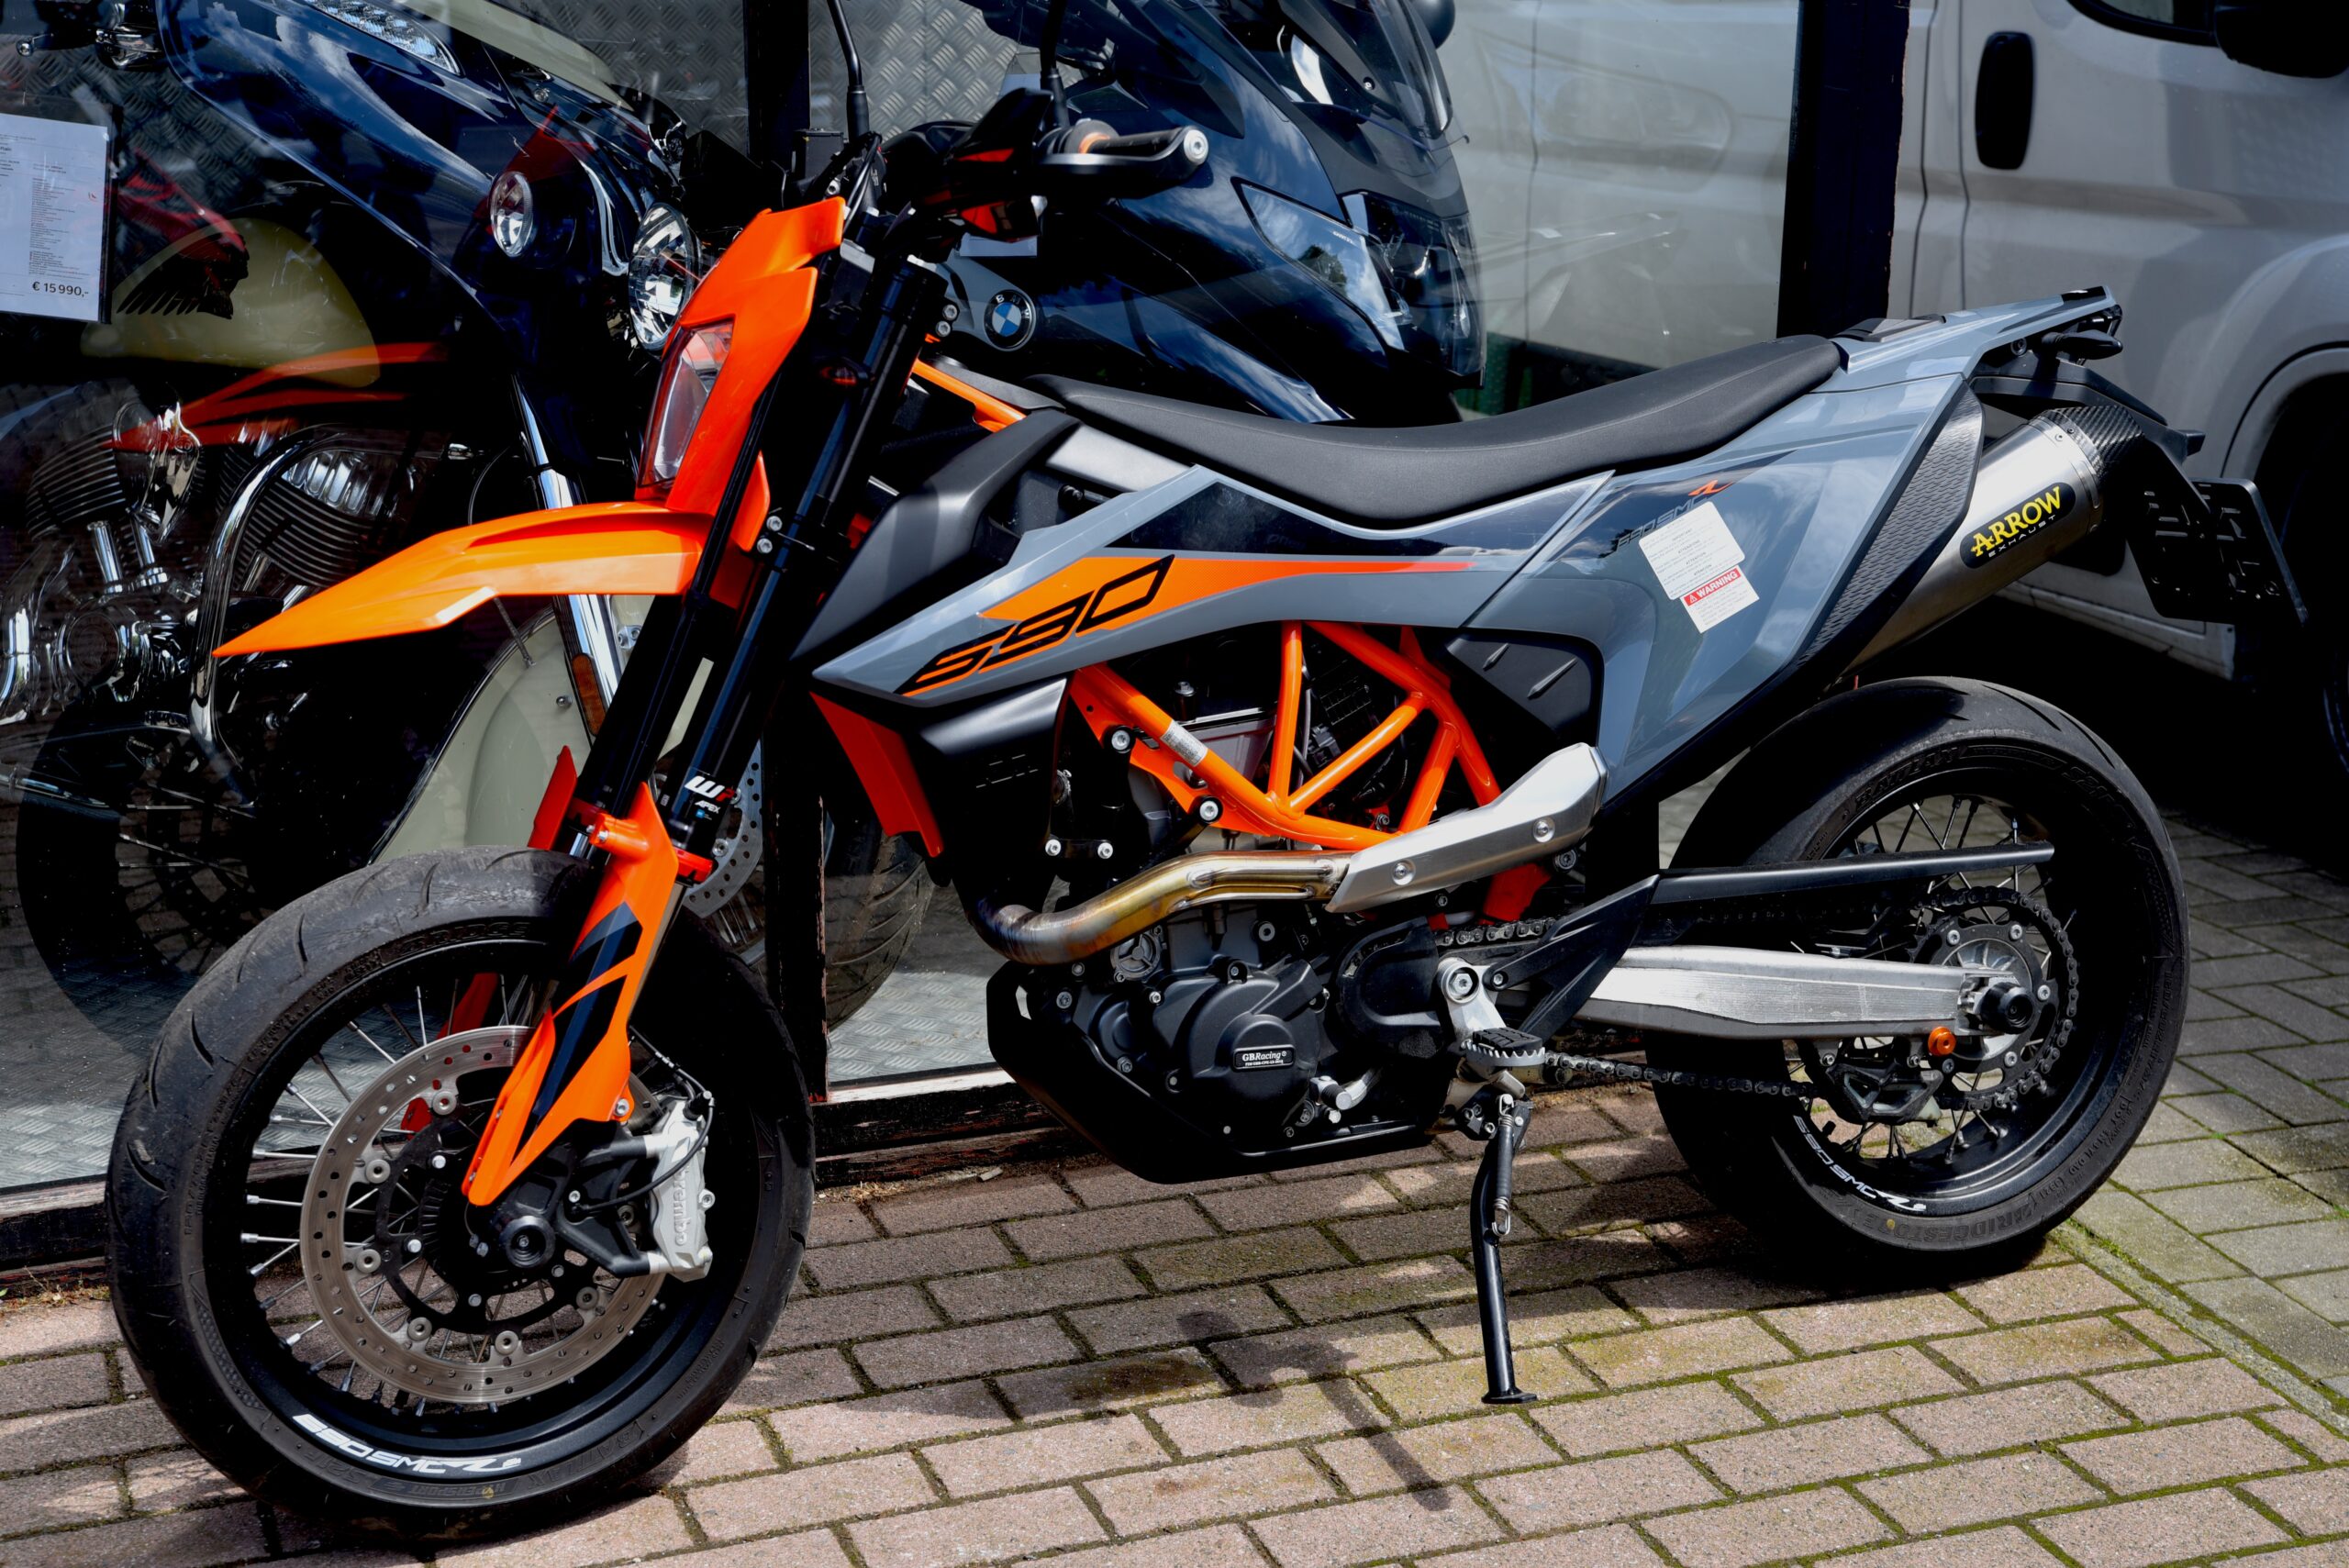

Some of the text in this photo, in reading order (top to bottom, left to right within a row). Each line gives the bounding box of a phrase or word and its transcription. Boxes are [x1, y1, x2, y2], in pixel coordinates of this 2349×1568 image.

[1970, 485, 2061, 557] ARROW
[1988, 514, 2056, 558] EXHAUST
[1697, 571, 1739, 598] WARNING
[893, 554, 1130, 695] 690
